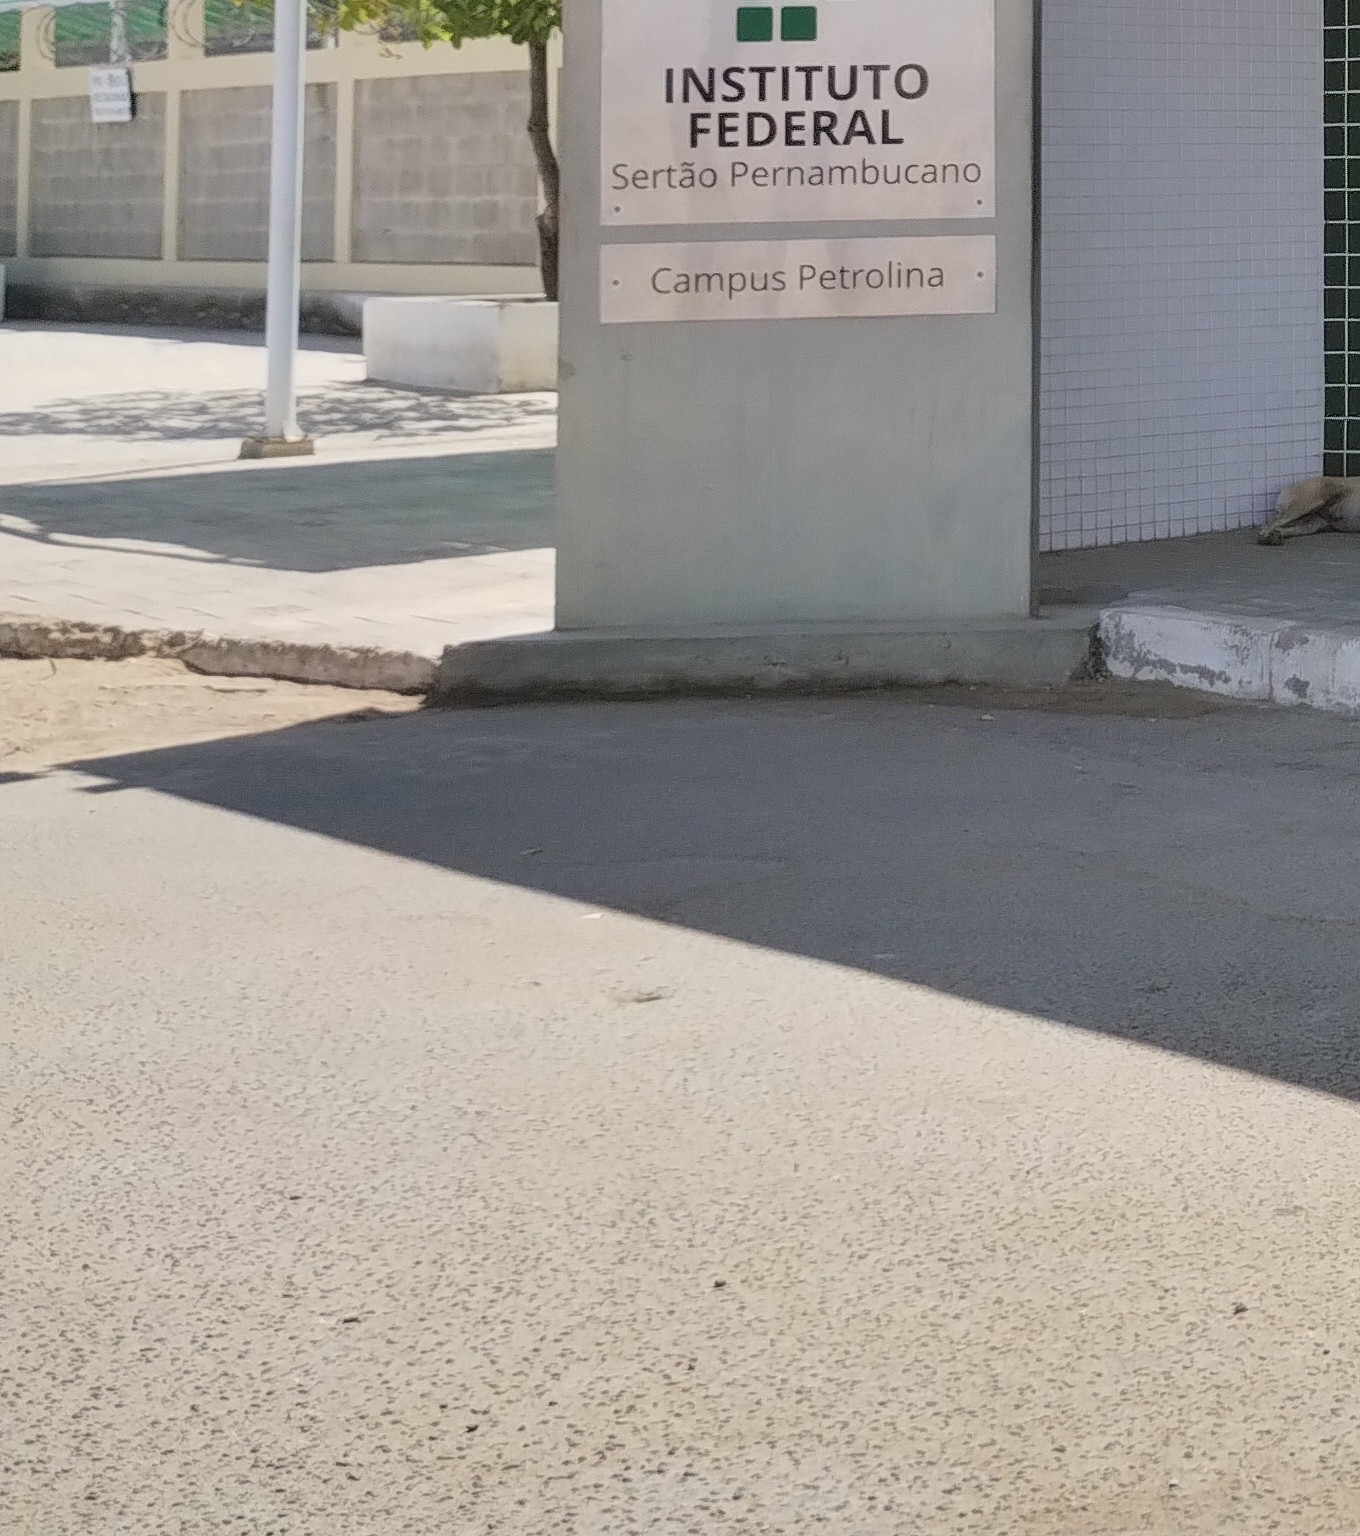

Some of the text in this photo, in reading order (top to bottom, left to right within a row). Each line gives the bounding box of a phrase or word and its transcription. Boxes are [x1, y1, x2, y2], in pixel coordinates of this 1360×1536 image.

[664, 62, 931, 105] INSTITUTO
[688, 108, 906, 151] FEDERAL
[611, 157, 983, 191] Sertão Pernambucano
[650, 260, 946, 301] Campus Petrolina
